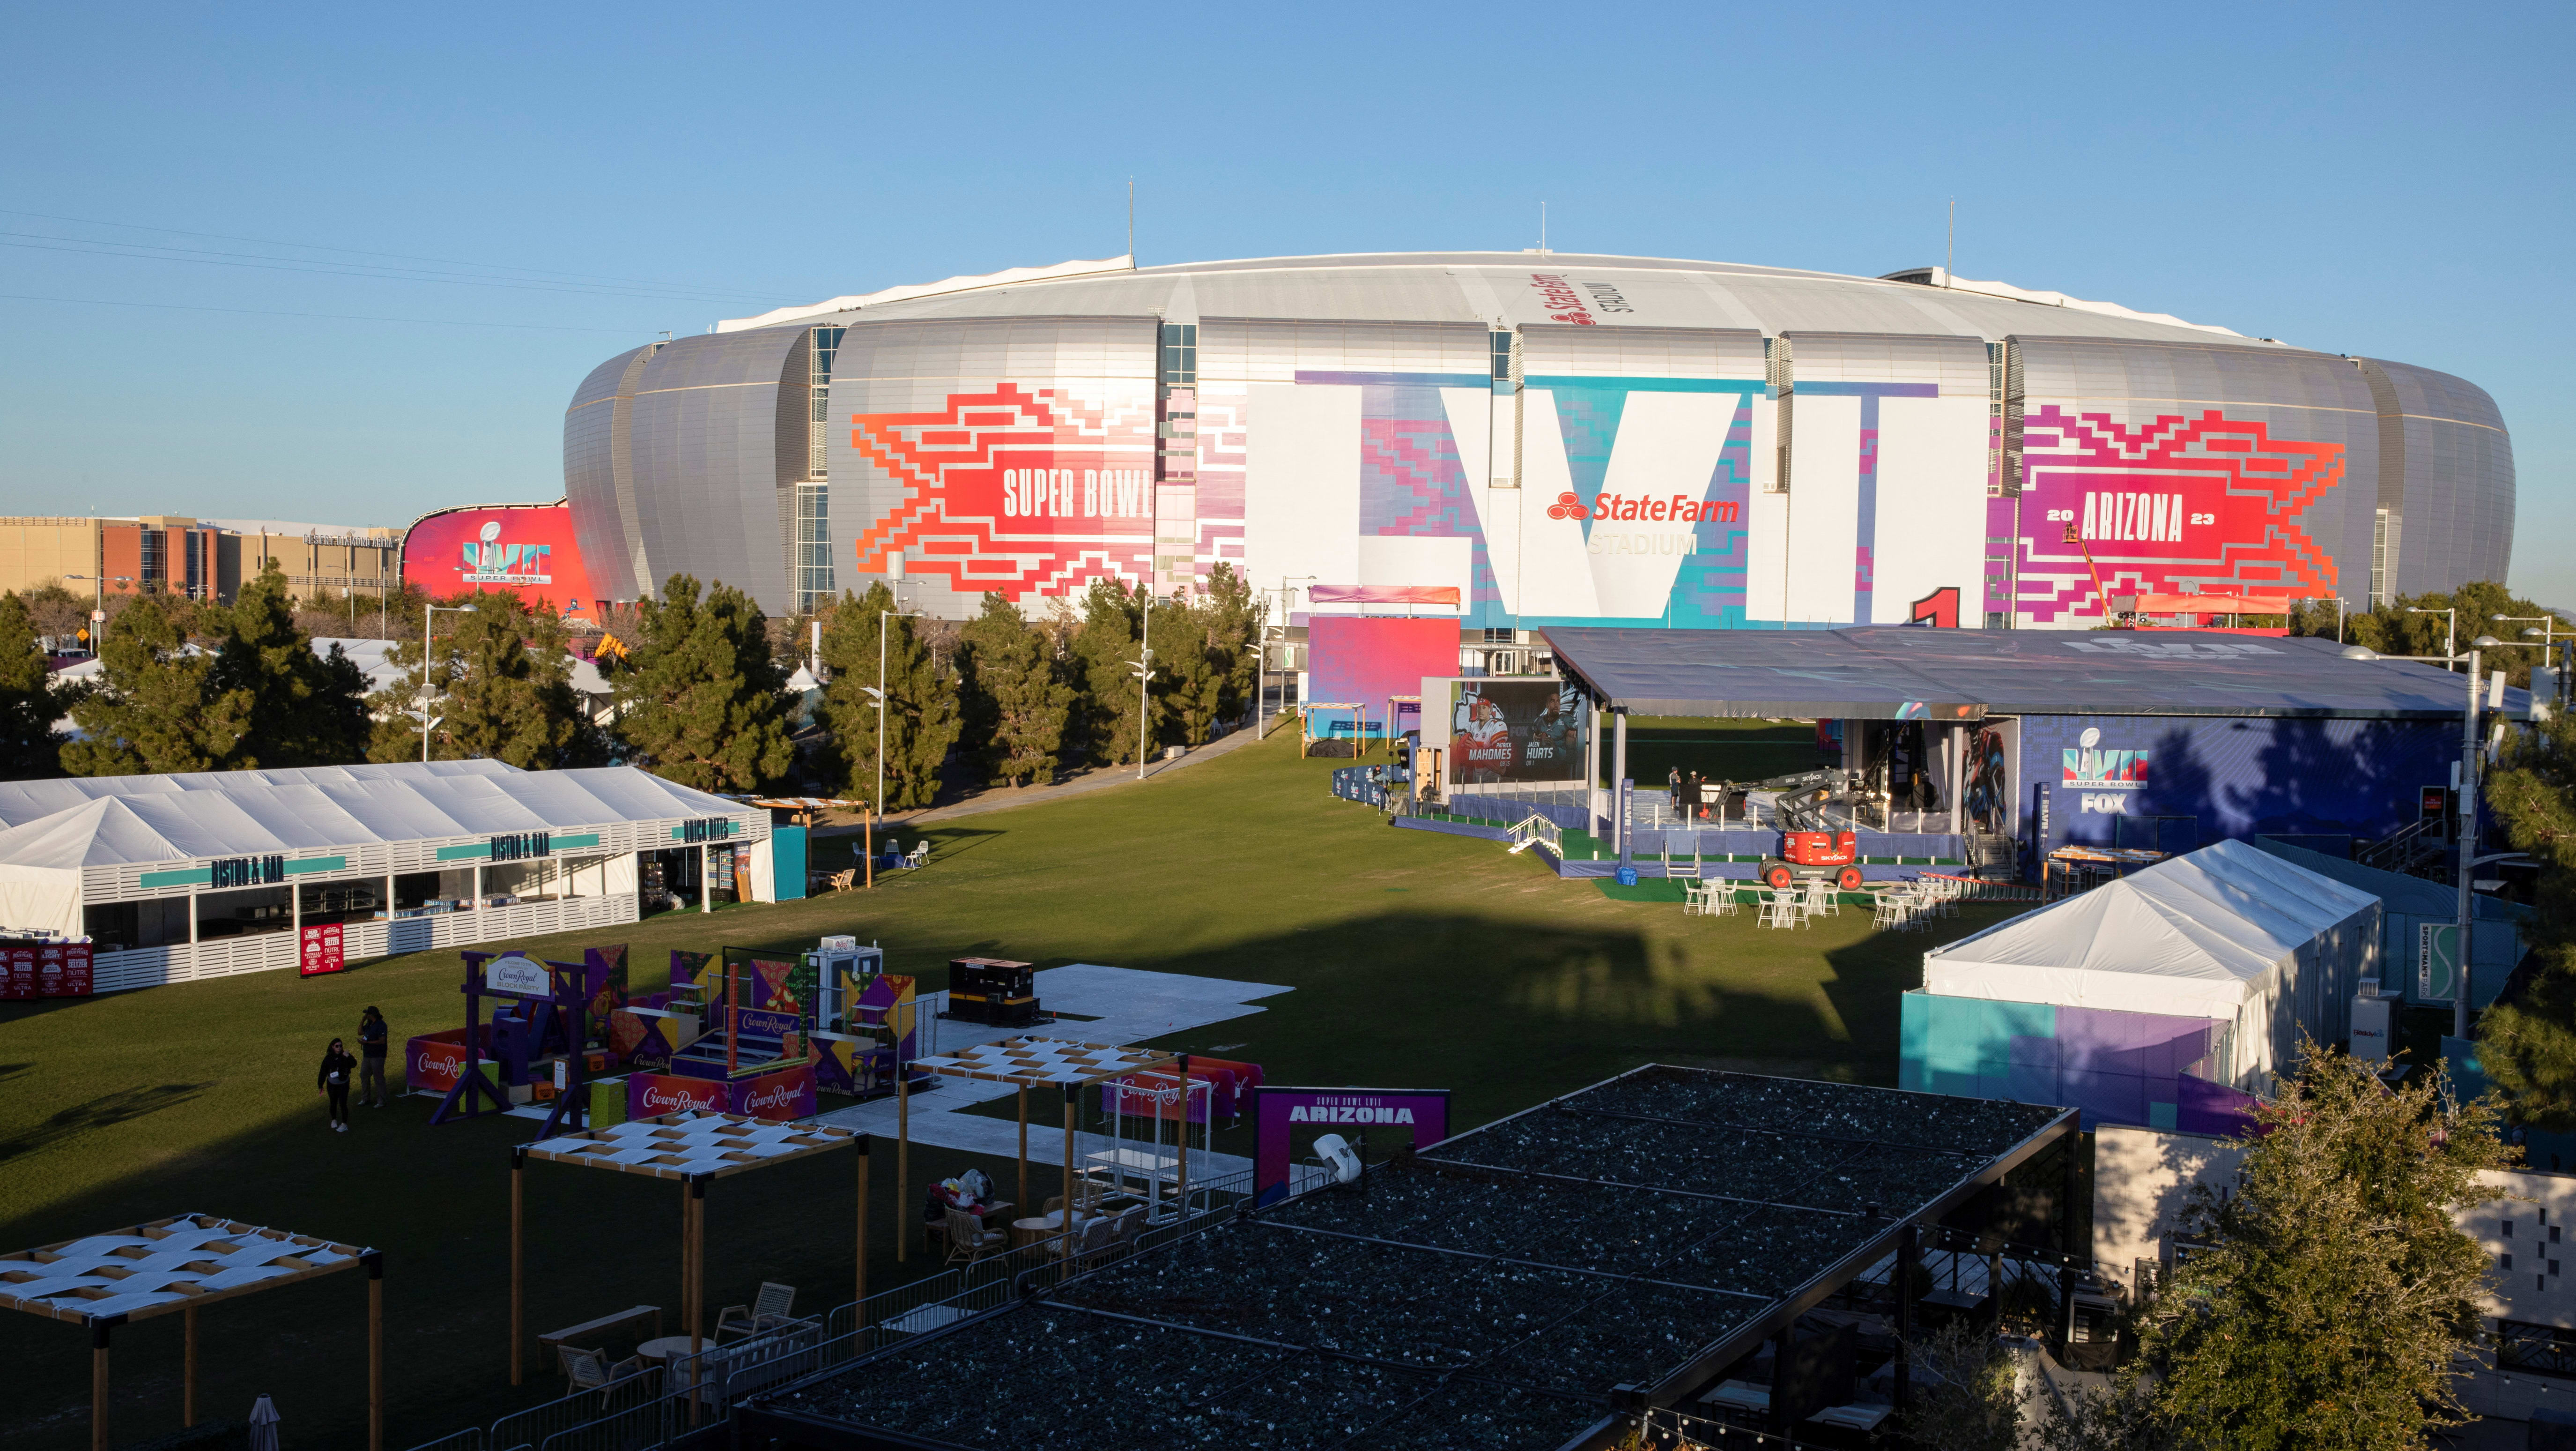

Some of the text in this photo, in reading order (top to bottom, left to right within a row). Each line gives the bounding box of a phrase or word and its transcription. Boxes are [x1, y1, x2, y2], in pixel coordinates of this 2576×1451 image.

[1582, 283, 1634, 313] STADIUM
[1004, 469, 1152, 518] SUPER BOWL
[2047, 492, 2215, 542] 20 ARIZONA 23
[303, 534, 393, 548] DESERT DIAMOND ARENA
[1588, 533, 1697, 555] STADIUM
[463, 543, 550, 575] LVII
[1469, 749, 1511, 760] MAHOMES
[1526, 748, 1553, 759] HURTS
[2063, 749, 2148, 781] LVII
[1802, 773, 1822, 781] SKYJACK
[2081, 793, 2127, 814] FOX
[684, 817, 728, 843] QUICK BITES
[491, 833, 549, 861] BISTRO & BAR
[212, 856, 284, 888] BISTRO & BAR
[499, 968, 538, 985] Crown Royal
[743, 1013, 794, 1034] Crown Royal
[643, 1087, 677, 1108] Crown
[744, 1081, 804, 1114] Crown Royal
[1317, 1097, 1381, 1107] SUPER BOWL LVII
[1289, 1106, 1414, 1124] ARIZONA
